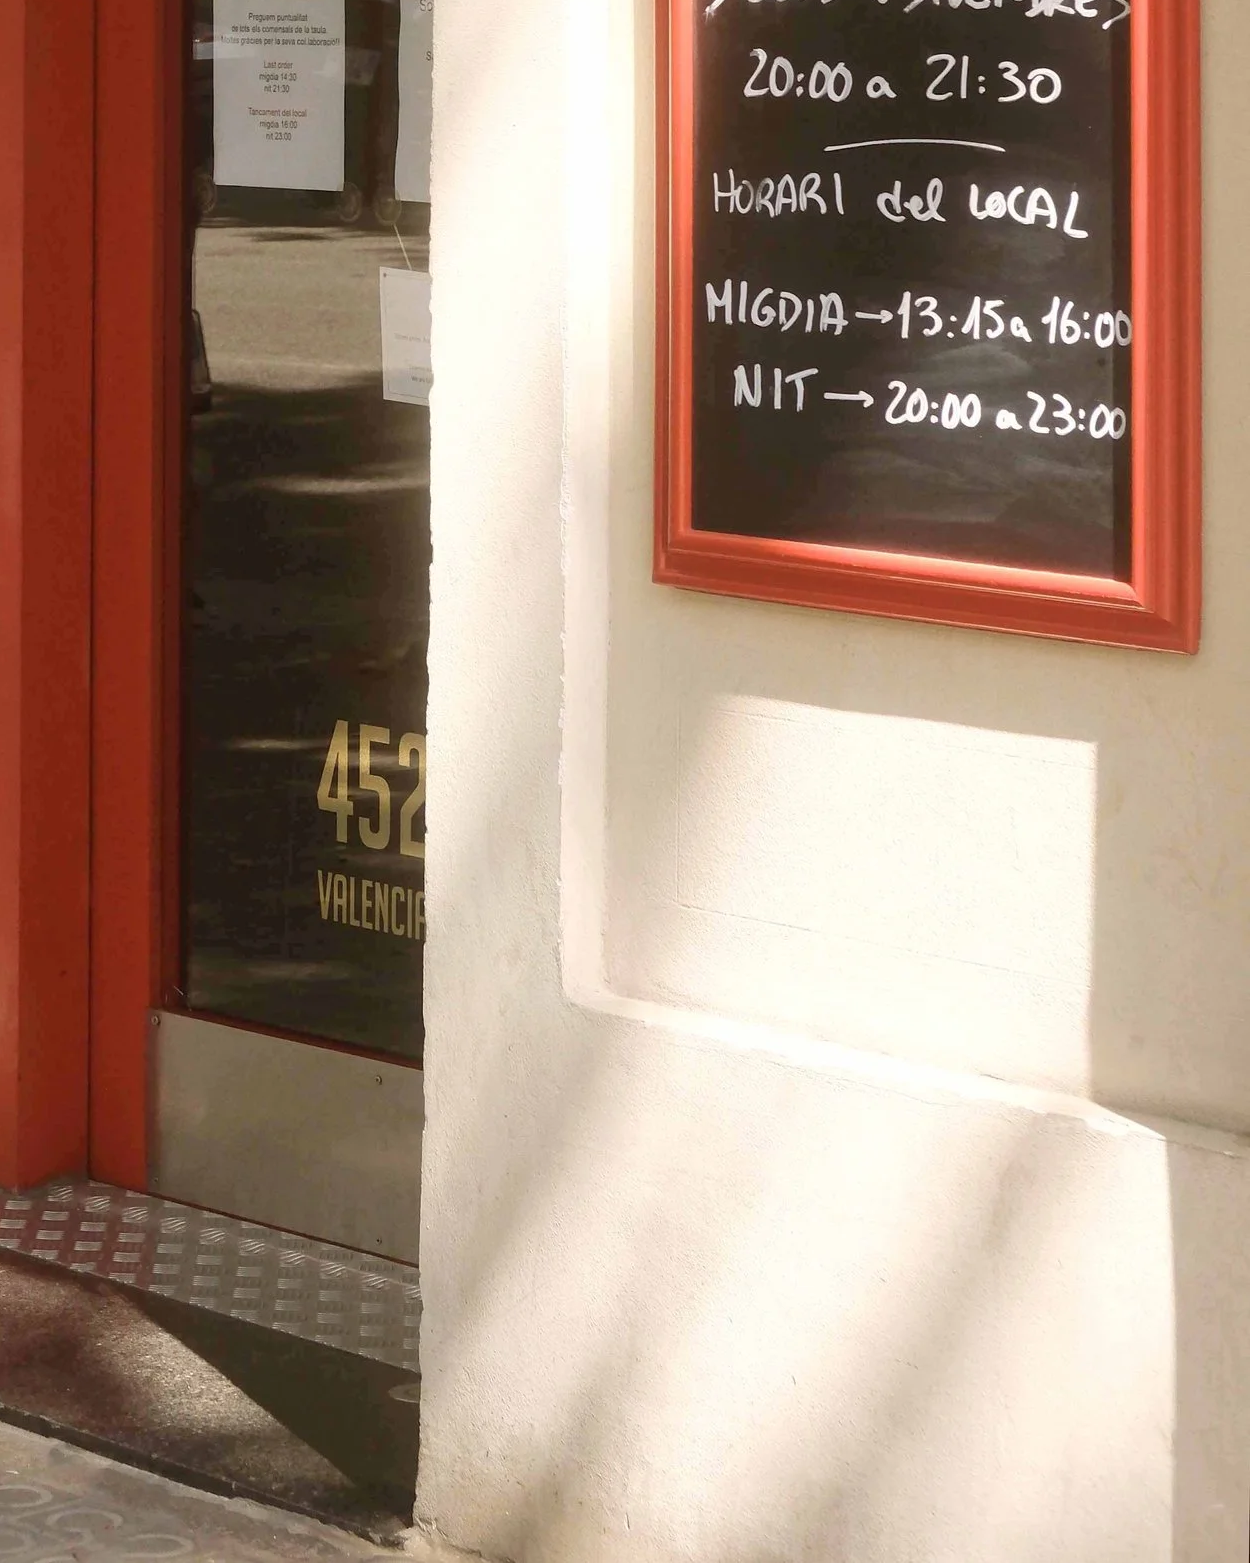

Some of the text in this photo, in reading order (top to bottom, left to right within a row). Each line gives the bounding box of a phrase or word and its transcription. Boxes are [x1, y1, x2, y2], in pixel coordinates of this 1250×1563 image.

[743, 48, 1062, 104] 20:00 a 21:30
[713, 168, 1089, 238] HORARI del LOCAL
[705, 279, 1132, 348] MIGDIA 13:15 a 16:00
[733, 363, 1126, 439] NIT 20:00 a 23:00
[317, 719, 427, 858] 452
